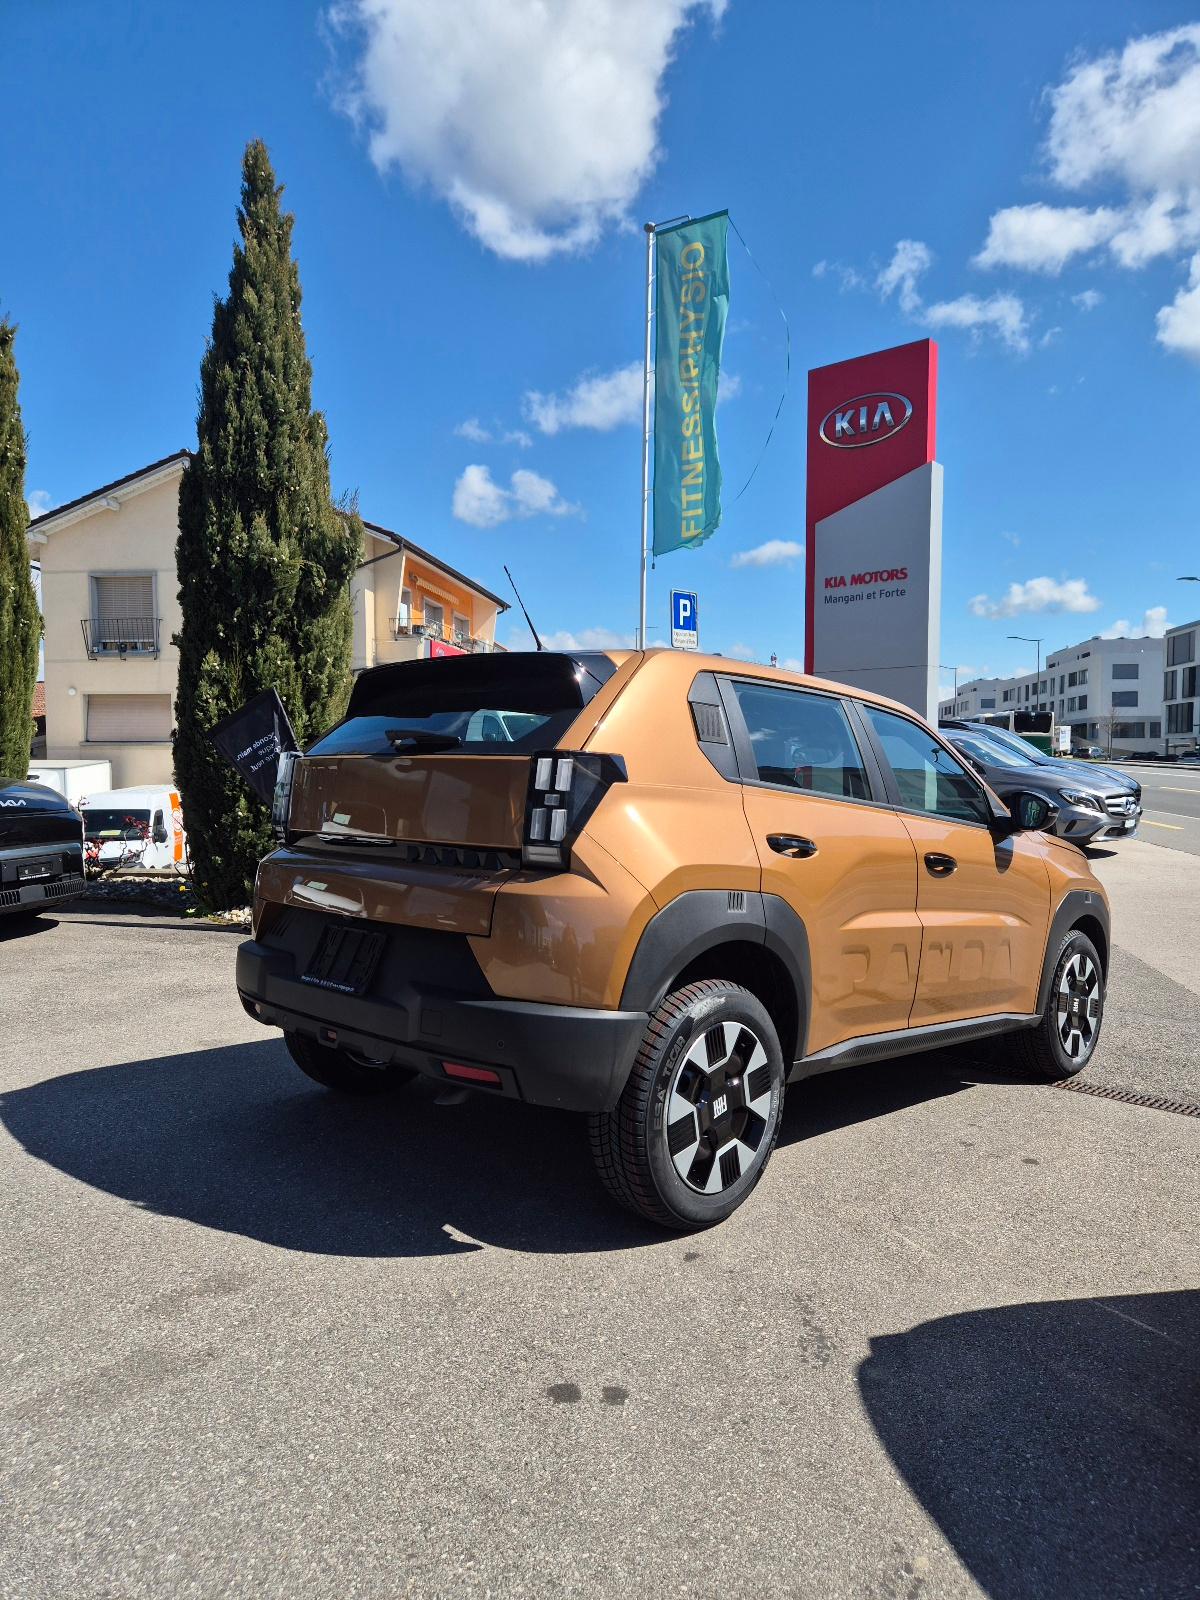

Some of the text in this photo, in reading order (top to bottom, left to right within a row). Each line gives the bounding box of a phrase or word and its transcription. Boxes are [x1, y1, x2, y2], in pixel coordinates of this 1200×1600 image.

[835, 401, 895, 438] KIA
[824, 567, 908, 588] KIA MOTORS
[824, 588, 906, 605] Mangani et Forte
[679, 598, 691, 626] P
